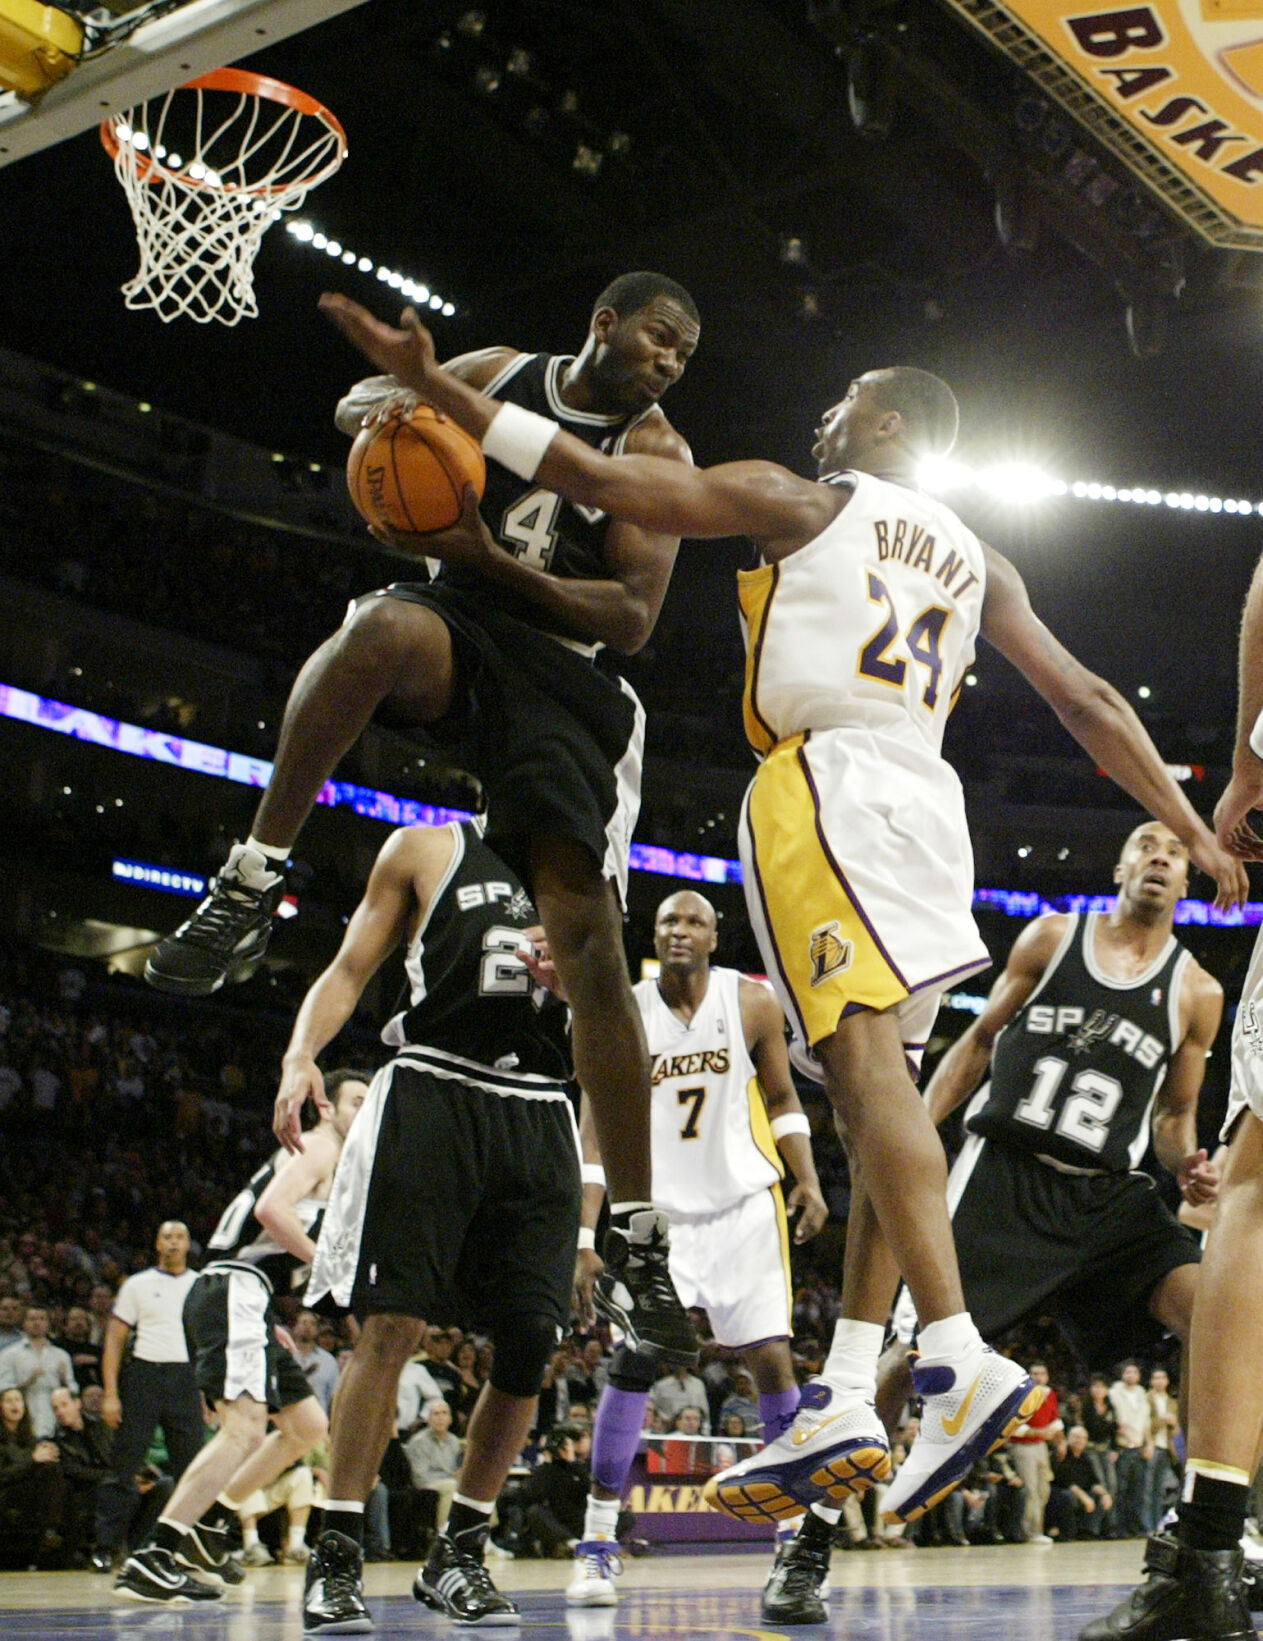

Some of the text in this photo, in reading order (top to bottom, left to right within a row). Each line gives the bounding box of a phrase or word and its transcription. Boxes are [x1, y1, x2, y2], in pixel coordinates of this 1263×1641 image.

[503, 488, 562, 571] 4
[874, 519, 979, 599] BRYANT
[856, 569, 954, 714] 24
[1027, 1005, 1165, 1068] SPURS
[677, 1086, 708, 1141] 7
[1013, 1056, 1123, 1153] 12
